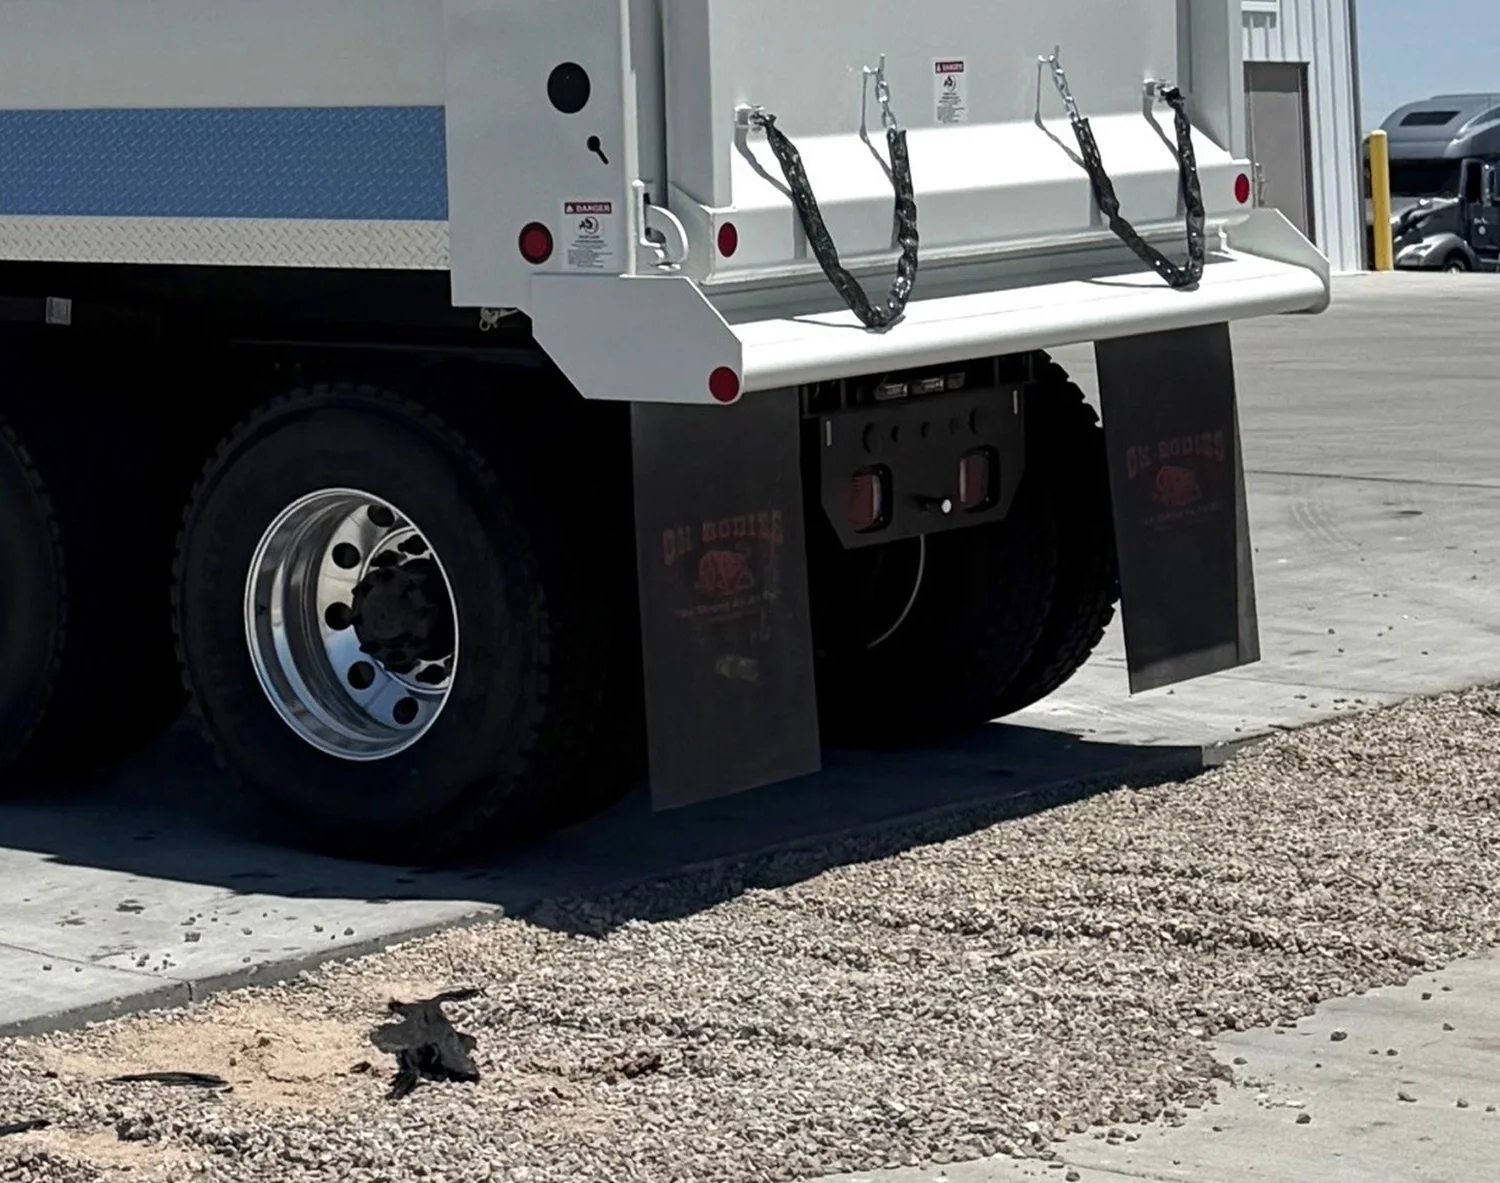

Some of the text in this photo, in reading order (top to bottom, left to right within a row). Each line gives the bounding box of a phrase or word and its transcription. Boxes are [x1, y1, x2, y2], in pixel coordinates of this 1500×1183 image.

[575, 204, 610, 213] DANGER
[1157, 429, 1225, 463] BODIES
[701, 509, 785, 546] BODIES
